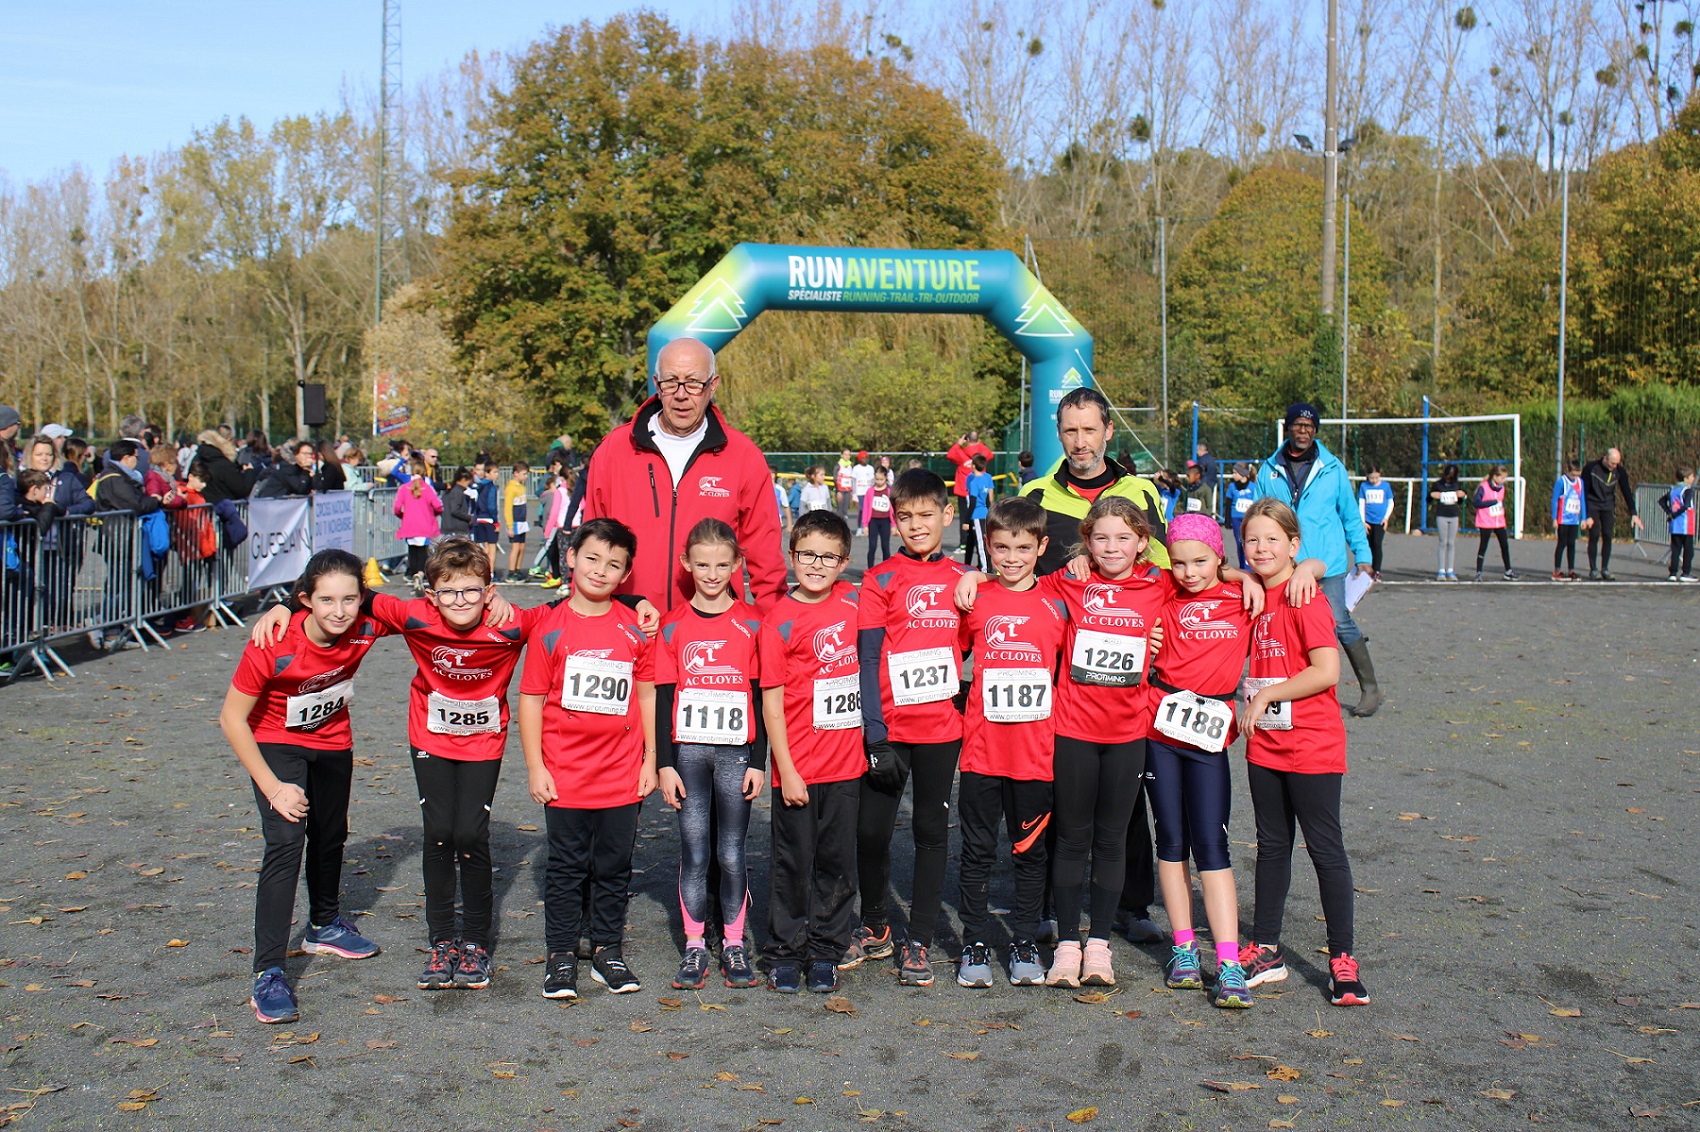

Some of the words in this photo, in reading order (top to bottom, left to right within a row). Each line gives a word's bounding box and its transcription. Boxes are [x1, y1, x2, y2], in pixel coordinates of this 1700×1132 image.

[787, 287, 842, 302] SPÉCIALISTE
[906, 619, 920, 629] AC
[1081, 615, 1097, 624] AC
[1099, 616, 1145, 628] CLOYES
[1178, 630, 1194, 640] AC
[1195, 630, 1238, 640] CLOYES
[984, 651, 998, 660] AC
[1000, 651, 1042, 663] CLOYES
[1084, 647, 1135, 671] 1226
[431, 666, 446, 677] AC
[448, 670, 493, 681] CLOYES
[818, 663, 834, 676] AC
[899, 665, 948, 689] 1237
[1085, 671, 1126, 683] PROTIMING
[569, 672, 629, 702] 1290
[685, 676, 700, 686] AC
[701, 675, 743, 685] CLOYES
[988, 684, 1047, 708] 1187
[298, 696, 345, 722] 1284
[437, 708, 490, 726] 1285
[682, 704, 743, 731] 1118
[1166, 701, 1225, 739] 1188
